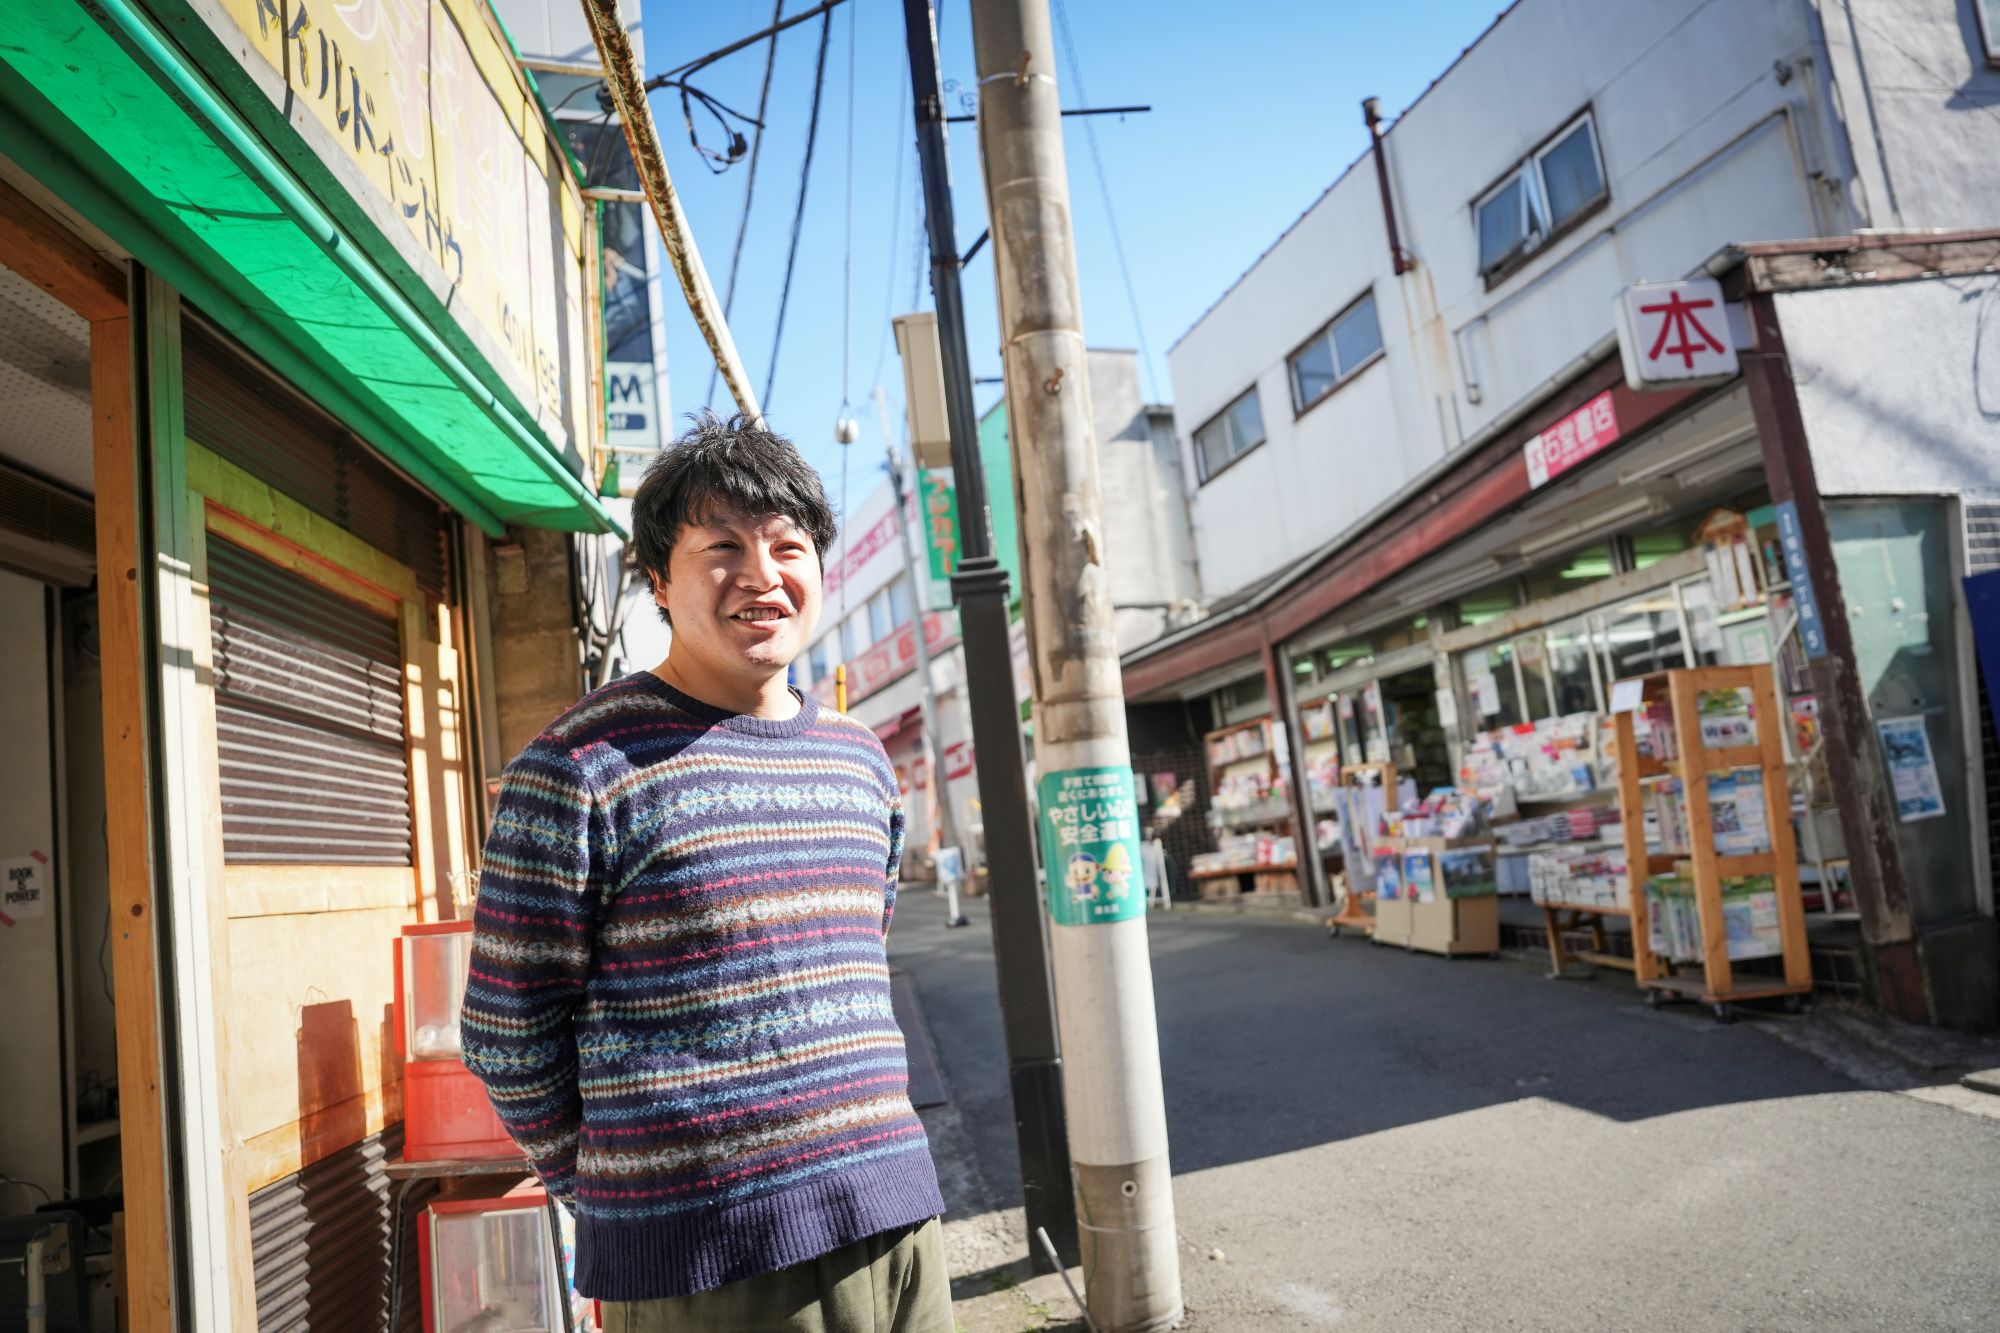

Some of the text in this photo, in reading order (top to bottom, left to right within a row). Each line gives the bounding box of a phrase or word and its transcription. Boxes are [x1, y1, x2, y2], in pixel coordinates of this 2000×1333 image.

[1640, 290, 1726, 369] 本
[1059, 821, 1132, 846] 安全運転
[9, 866, 34, 881] BOOK
[5, 888, 40, 904] POWER!
